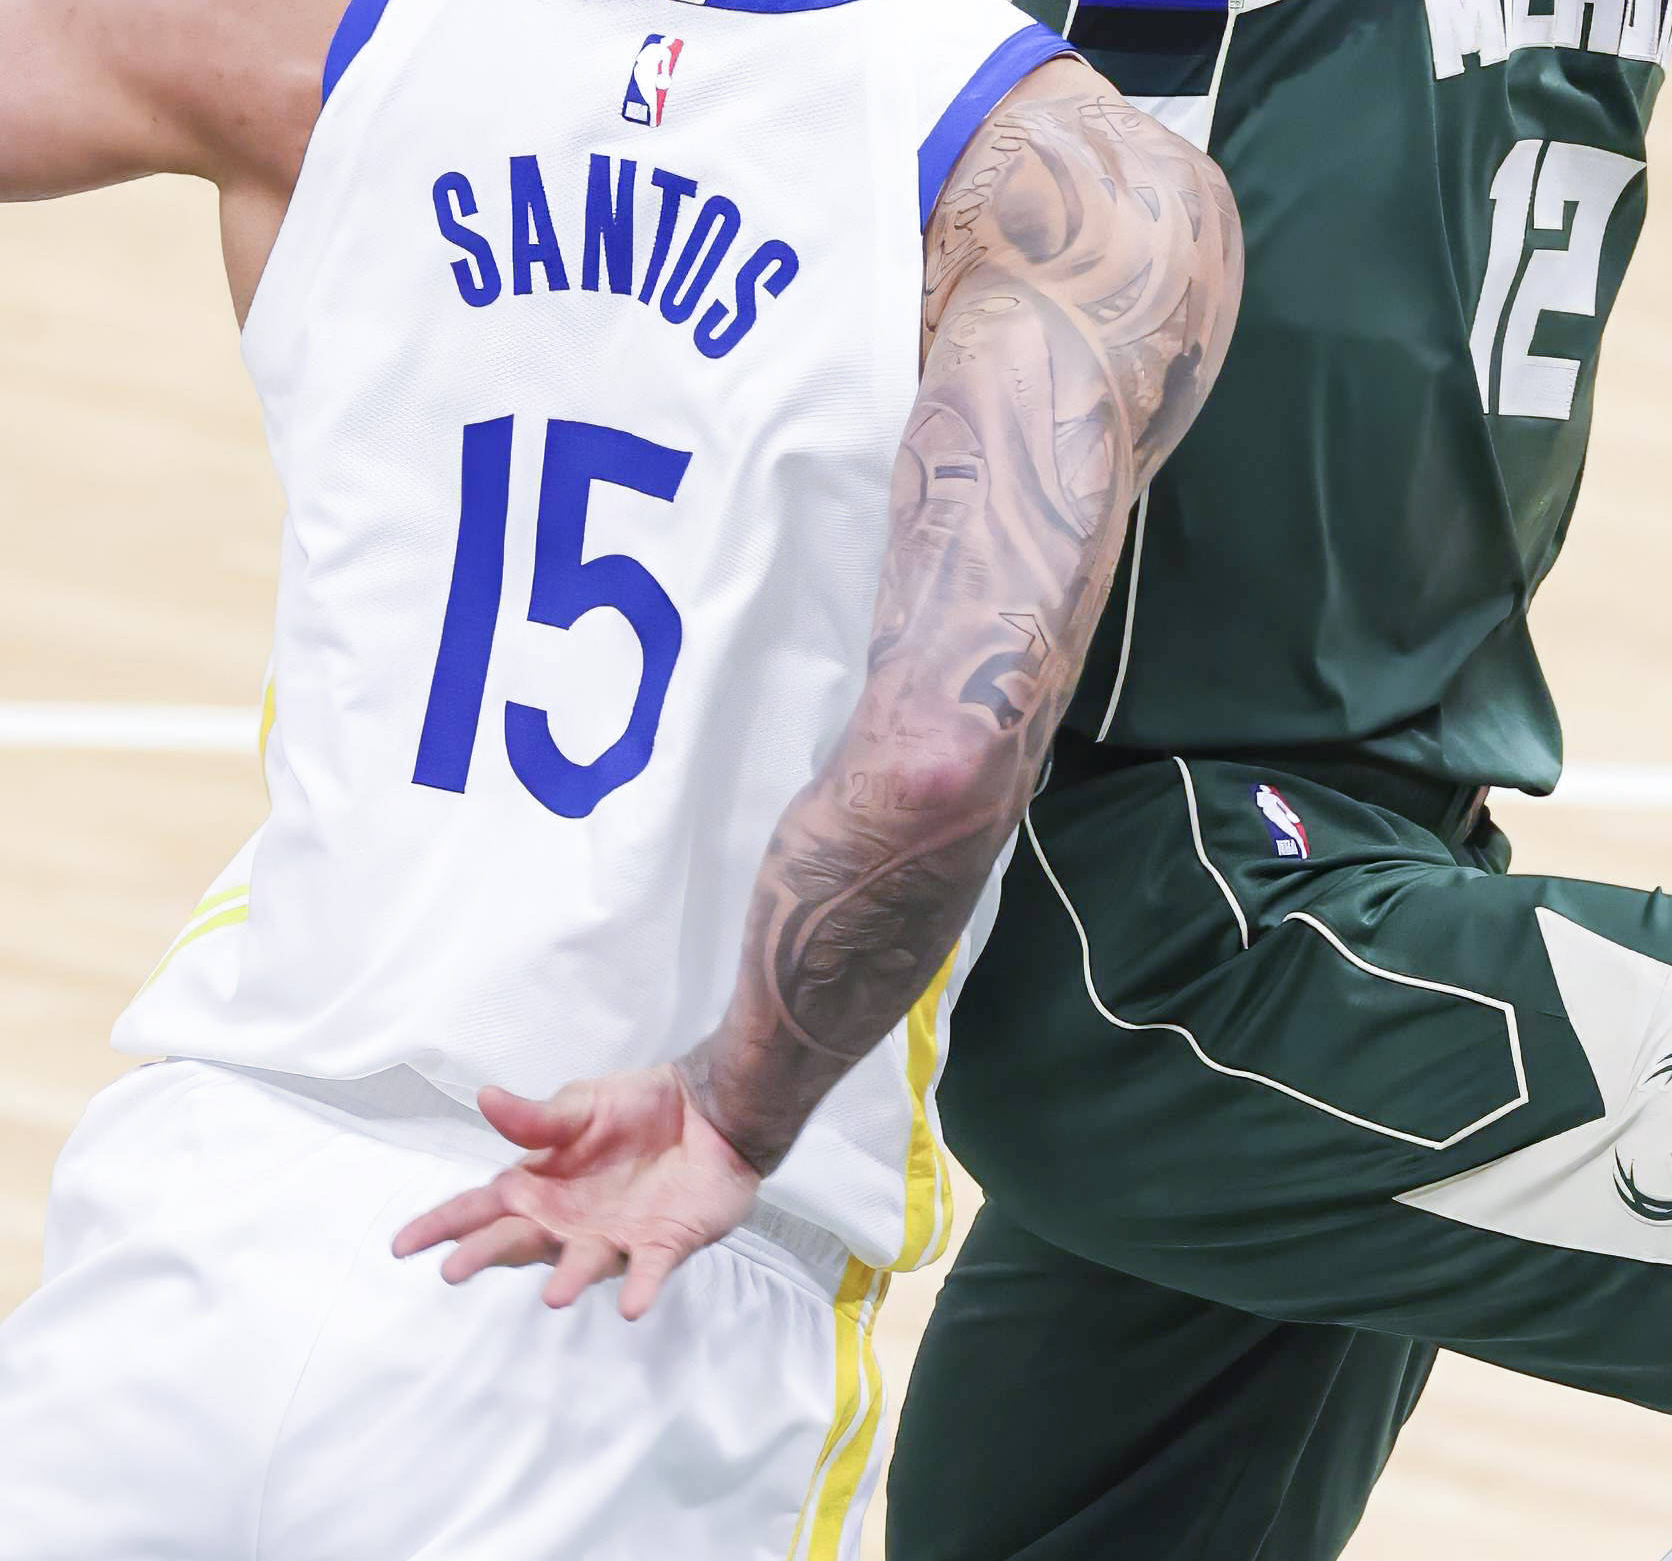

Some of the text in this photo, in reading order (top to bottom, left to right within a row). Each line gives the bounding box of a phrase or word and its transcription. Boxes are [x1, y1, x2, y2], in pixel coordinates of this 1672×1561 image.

[432, 153, 798, 358] SANTOS
[1469, 139, 1645, 420] 12
[411, 414, 692, 818] 15
